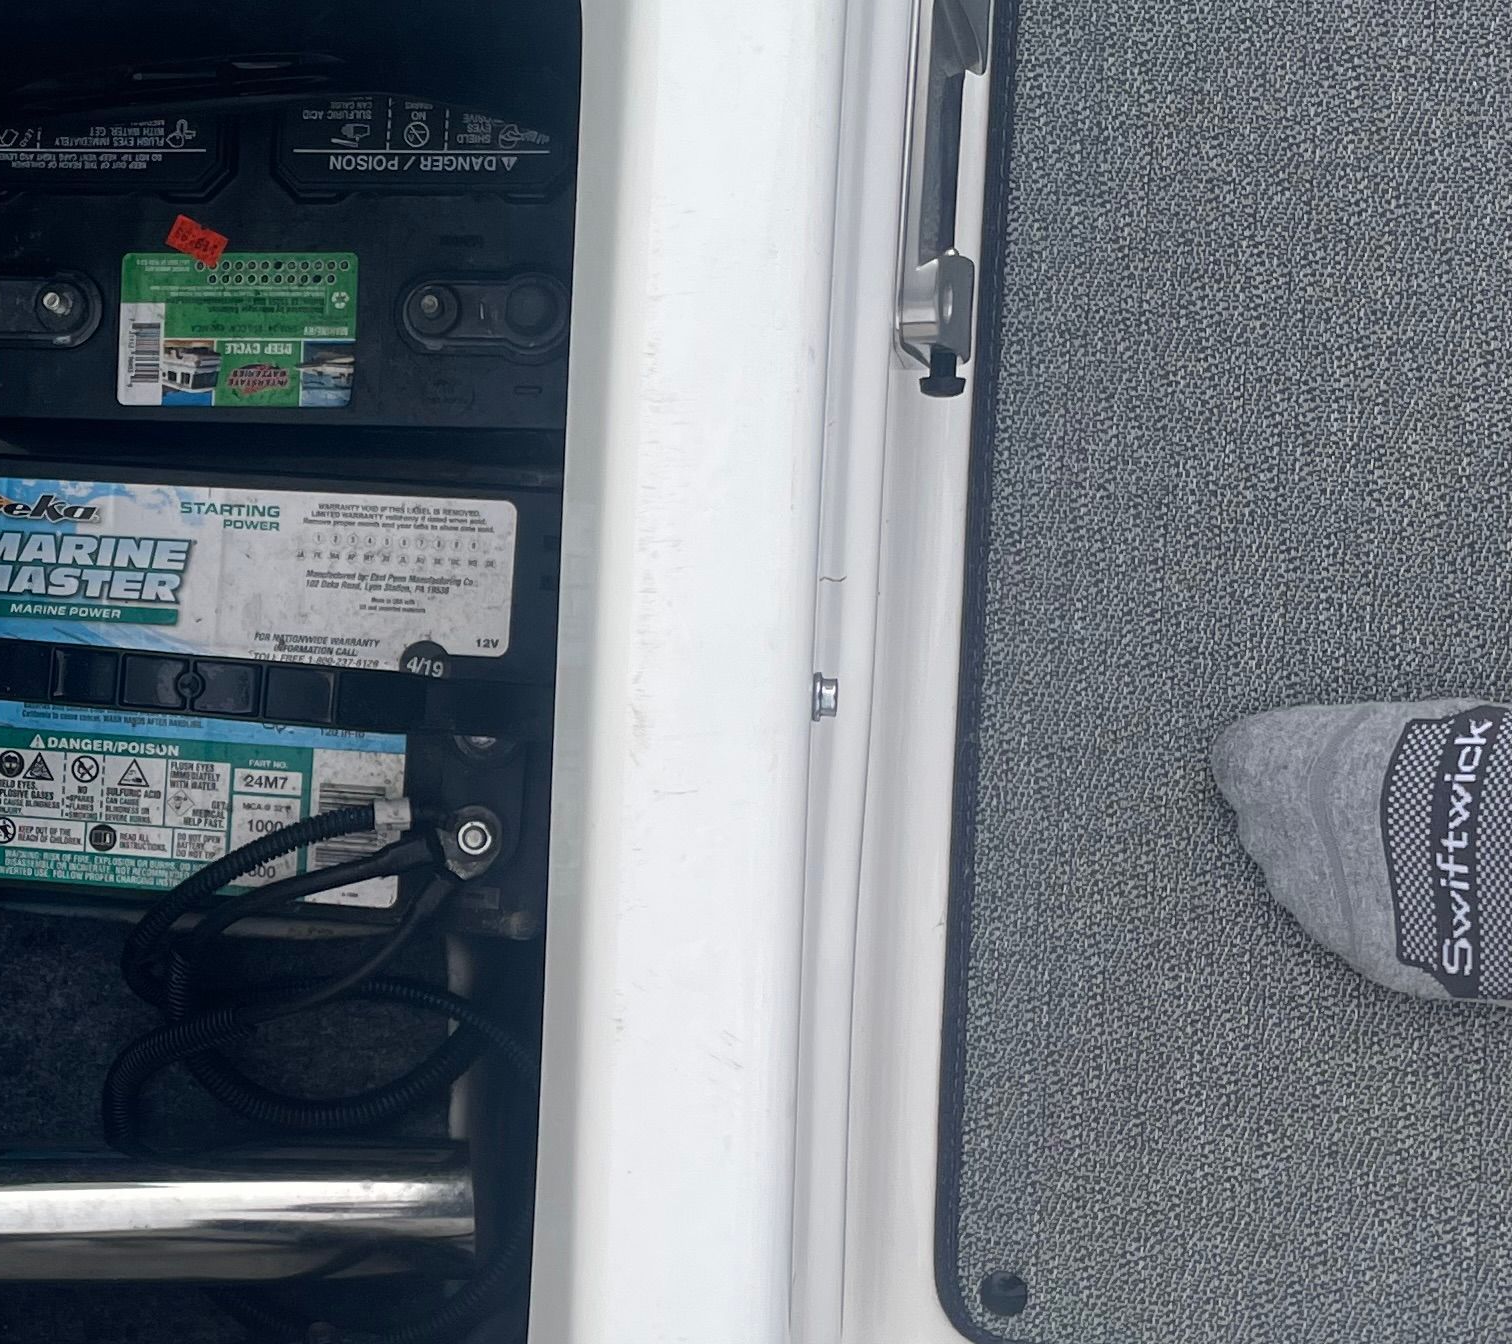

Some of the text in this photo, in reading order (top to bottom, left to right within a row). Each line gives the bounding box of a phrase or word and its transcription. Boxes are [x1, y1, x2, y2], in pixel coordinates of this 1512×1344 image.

[302, 110, 372, 119] SULFURIC ACID
[411, 111, 426, 120] NO
[113, 137, 135, 146] EYES
[137, 137, 164, 146] FLUSH
[456, 134, 491, 144] SHIELD
[329, 155, 398, 170] POISON
[419, 156, 496, 171] DANGER
[225, 343, 292, 355] DEEP CYCLE
[180, 502, 280, 518] STARTING
[223, 519, 280, 532] POWER
[10, 604, 121, 619] MARINE POWER
[254, 632, 380, 647] FOR NATIONWIDE WARRANTY
[475, 638, 499, 649] 12V
[274, 643, 333, 656] INFORMATION
[406, 656, 444, 677] 4/19
[47, 737, 179, 757] DANGER/POISON
[196, 763, 215, 773] EYES
[249, 760, 288, 770] PART NO.
[170, 771, 220, 782] IMMEDIATELY
[244, 775, 288, 790] 24M7
[30, 791, 54, 801] GASES
[106, 787, 161, 799] SULFURIC ACID
[248, 819, 284, 833] 1000
[1436, 718, 1492, 977] Swiftwick
